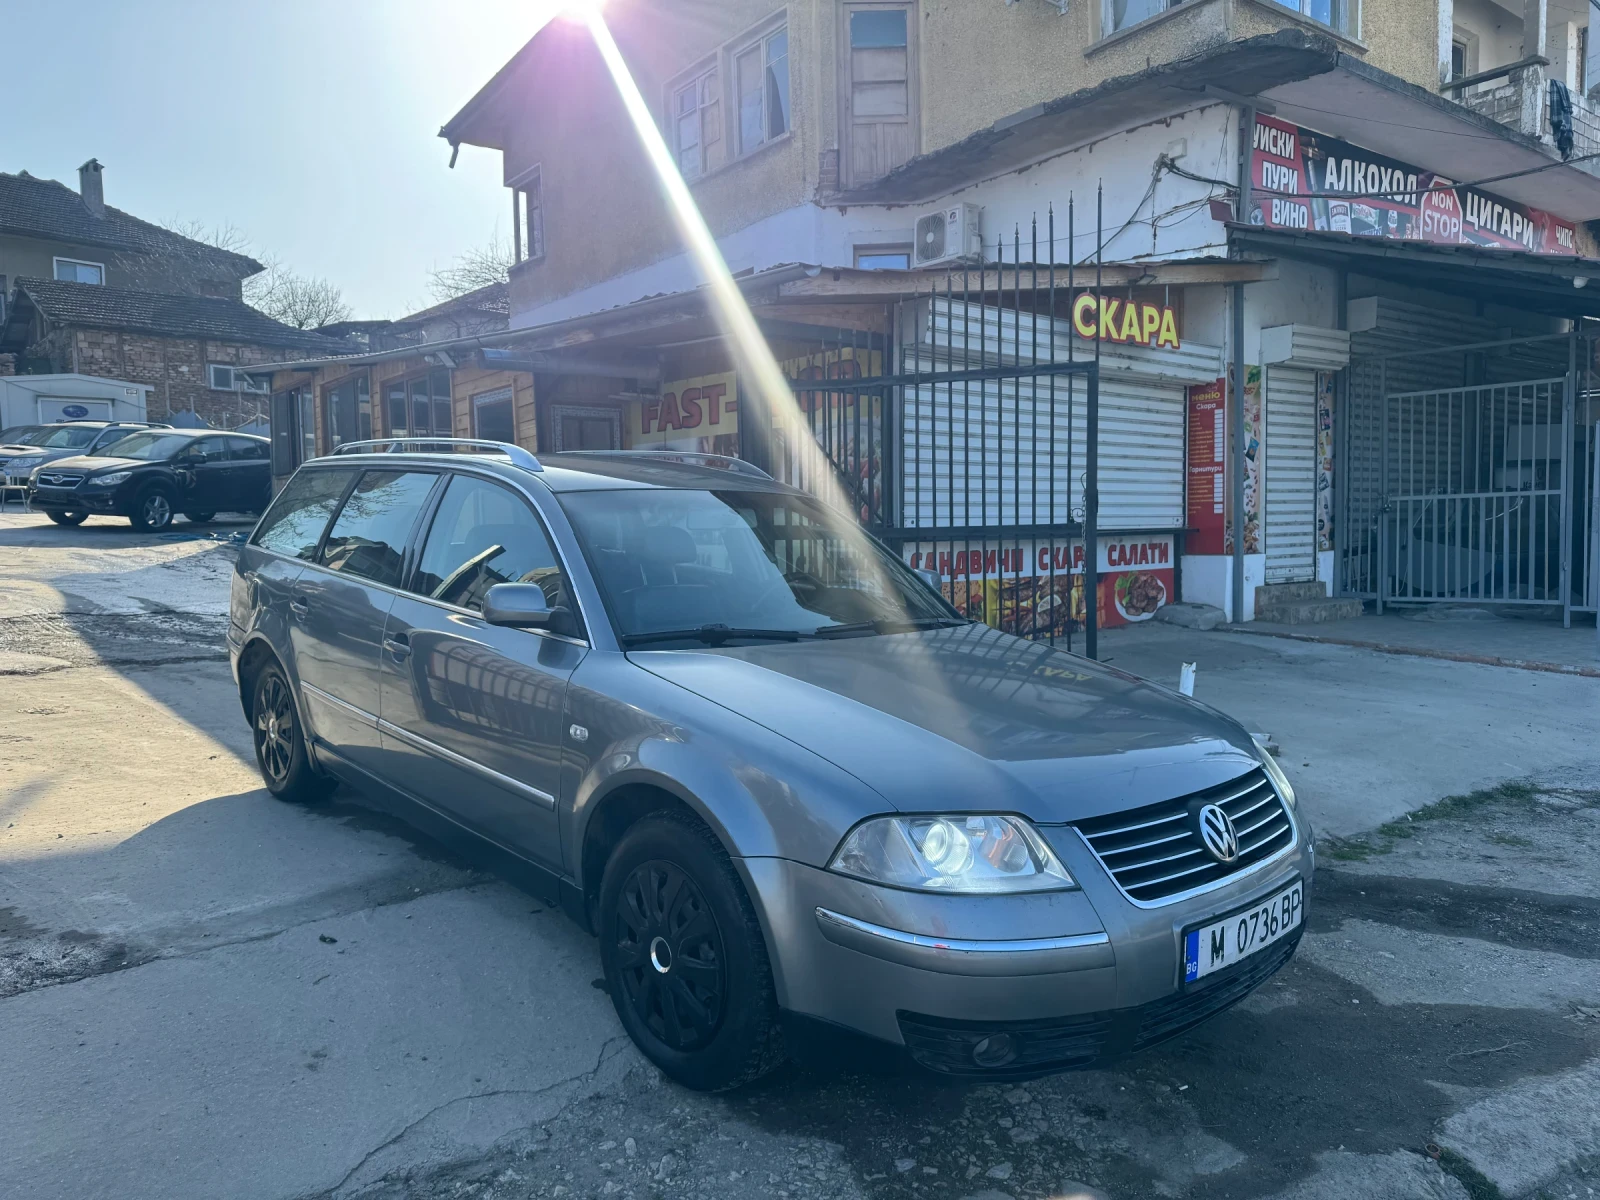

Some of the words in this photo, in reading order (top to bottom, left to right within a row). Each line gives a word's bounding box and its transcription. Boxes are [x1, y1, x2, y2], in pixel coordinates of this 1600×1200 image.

[1253, 123, 1294, 160] УИСКИ
[1262, 160, 1298, 195] ПУРИ
[1324, 156, 1417, 206] АЛКОХОЛ
[1271, 199, 1308, 229] ВИНО
[1431, 190, 1454, 212] NON
[1424, 208, 1460, 240] STOP
[1466, 191, 1534, 249] ЦИГАРИ
[1555, 224, 1573, 249] ЧИПС
[1073, 293, 1180, 348] СКАРА
[1196, 402, 1217, 411] Скара
[910, 547, 1023, 580] САНДВИЧИ
[1038, 541, 1086, 571] СКАР
[1107, 542, 1169, 567] САЛАТИ
[1211, 925, 1226, 968] M
[1237, 900, 1280, 954] 0736
[1281, 887, 1300, 931] BP
[1186, 961, 1197, 975] BG
